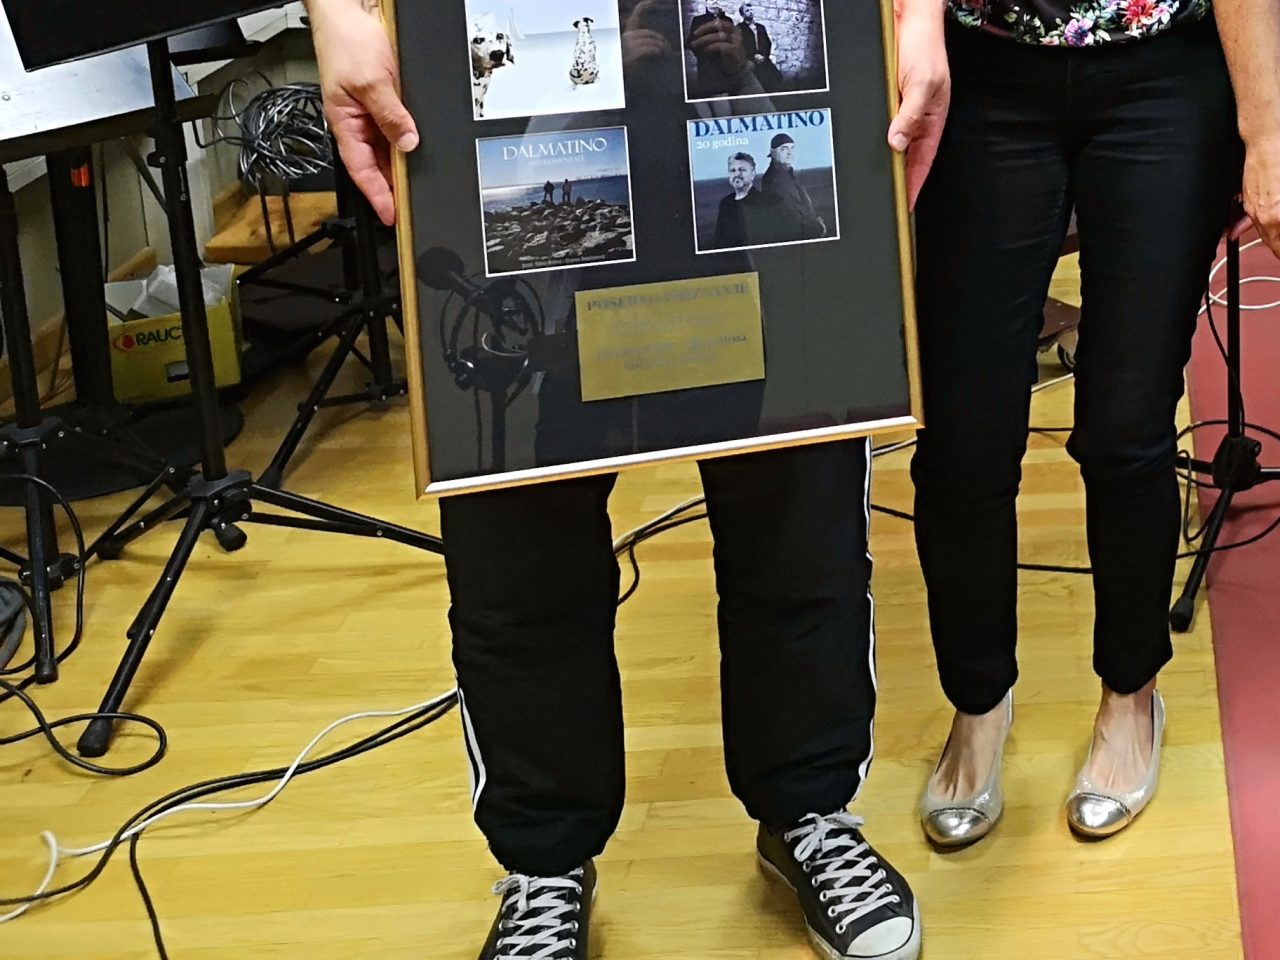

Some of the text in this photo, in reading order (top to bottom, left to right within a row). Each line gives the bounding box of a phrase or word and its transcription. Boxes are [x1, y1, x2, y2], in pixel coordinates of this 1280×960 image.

[694, 110, 825, 137] DALMATINO
[503, 137, 608, 160] DALMATINO
[696, 136, 749, 149] 20 godina
[135, 326, 183, 347] RAUC
